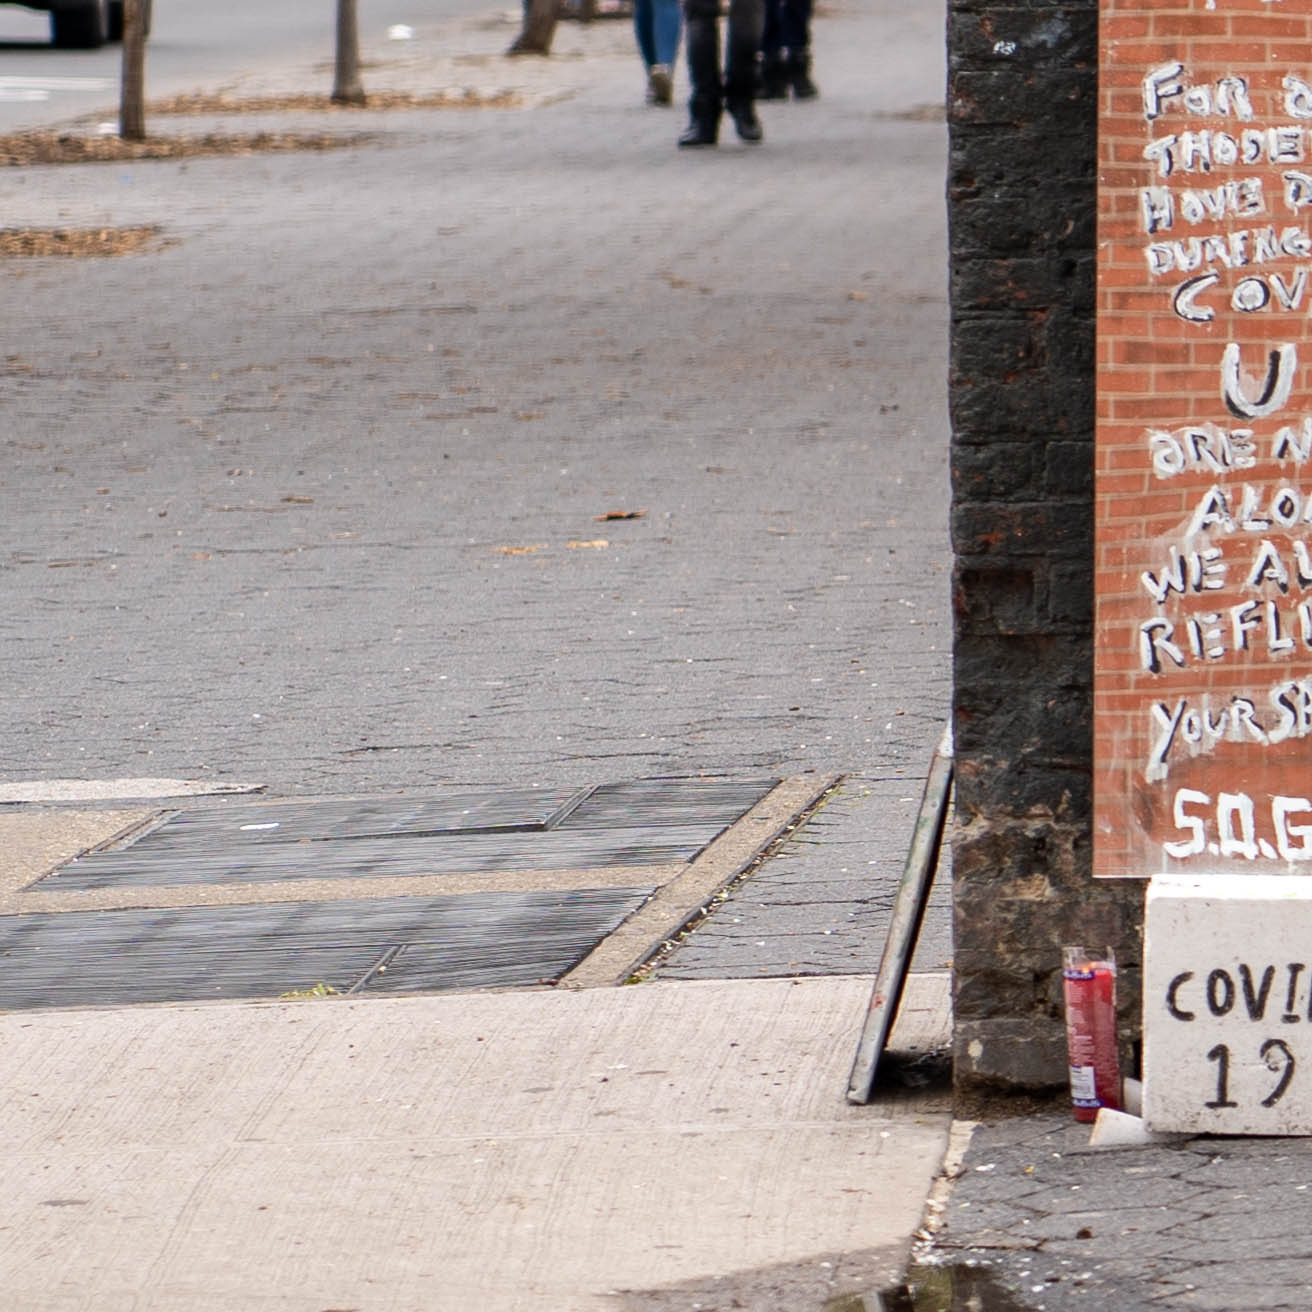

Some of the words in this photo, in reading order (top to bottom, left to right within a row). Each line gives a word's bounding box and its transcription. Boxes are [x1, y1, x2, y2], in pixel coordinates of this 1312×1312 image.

[1143, 125, 1305, 177] THOSE
[1144, 225, 1312, 275] DURING
[1220, 343, 1297, 421] U
[1141, 544, 1226, 604] WE
[1147, 692, 1269, 782] YOUR
[1205, 1038, 1296, 1110] 19
